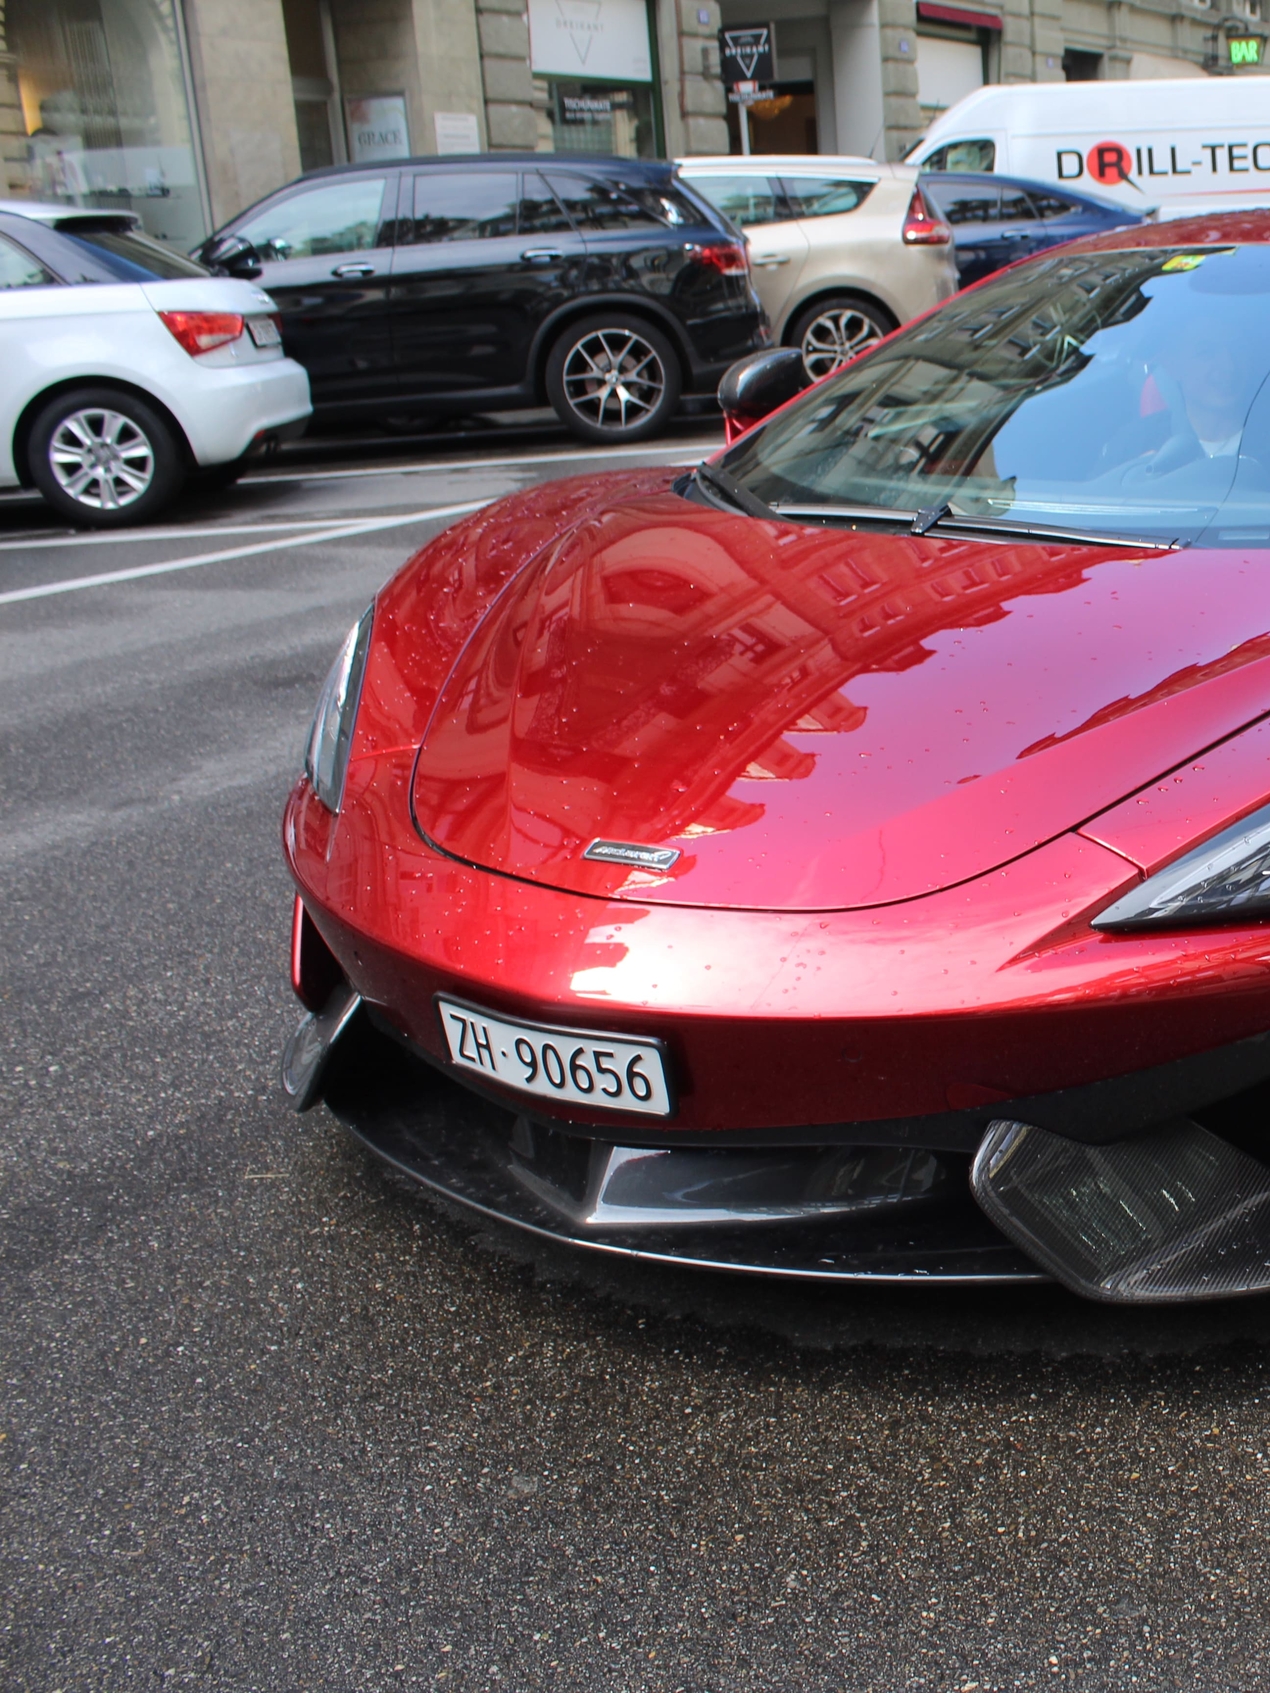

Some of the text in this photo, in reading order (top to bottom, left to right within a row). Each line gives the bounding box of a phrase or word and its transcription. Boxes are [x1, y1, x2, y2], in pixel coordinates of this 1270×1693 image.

[556, 18, 604, 33] DREIKANT
[724, 43, 769, 57] DREIKANT
[1231, 40, 1258, 64] BAR
[358, 130, 403, 146] GRACE
